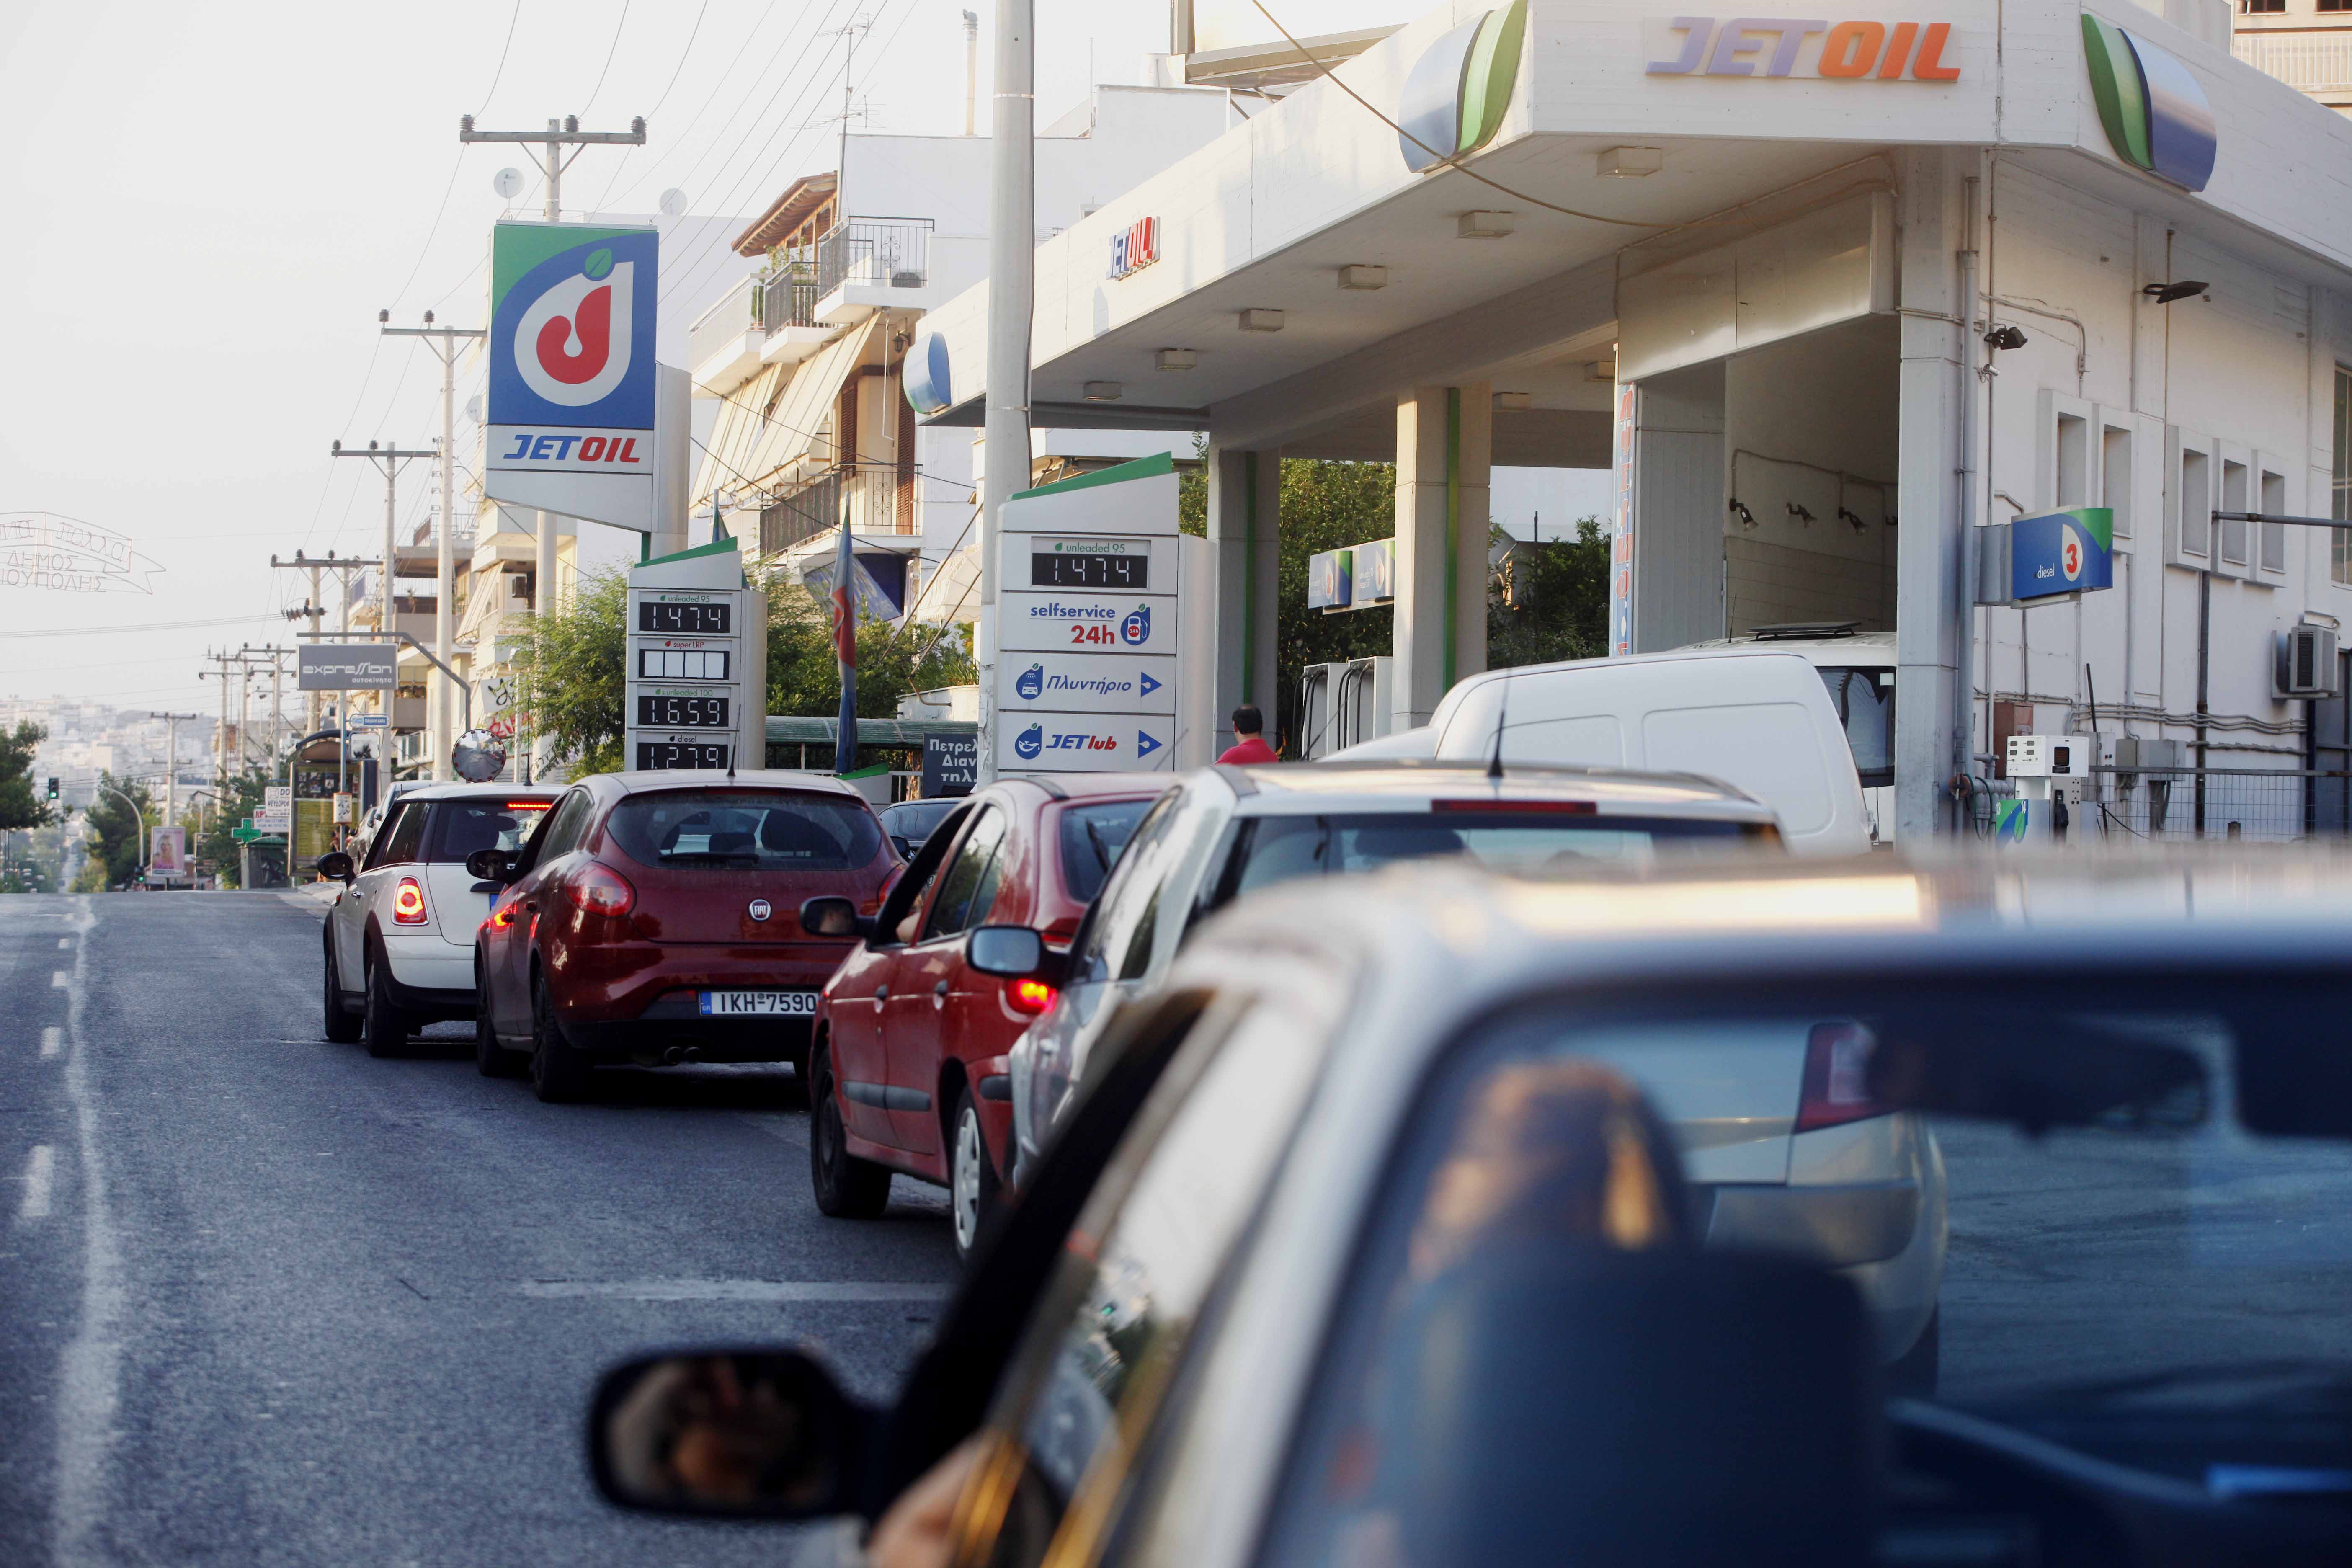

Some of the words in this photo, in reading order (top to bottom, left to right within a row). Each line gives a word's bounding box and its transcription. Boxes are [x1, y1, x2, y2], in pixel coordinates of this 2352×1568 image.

[1645, 16, 1962, 80] JETOIL
[503, 434, 640, 463] JETOIL
[1066, 542, 1110, 553] unleaded
[1112, 544, 1125, 553] 95
[7, 550, 79, 572] ΔΗΜΟΣ
[1055, 557, 1129, 583] 1.474
[2037, 562, 2054, 579] diesel
[2066, 544, 2078, 574] 3
[668, 595, 699, 603] unleaded
[653, 606, 721, 629] 1.474
[1031, 603, 1116, 618] selfservice
[1071, 625, 1115, 644] 24h
[673, 642, 692, 650] super
[1047, 675, 1132, 695] Πλυντήριο
[652, 699, 720, 724] 1.659
[1045, 735, 1117, 750] JETlub
[651, 747, 718, 769] 1.279
[942, 754, 977, 766] Διαν
[941, 769, 977, 783] τηλ.
[2021, 799, 2027, 814] 14
[754, 905, 767, 915] FIAT
[721, 993, 816, 1012] IKH-7590
